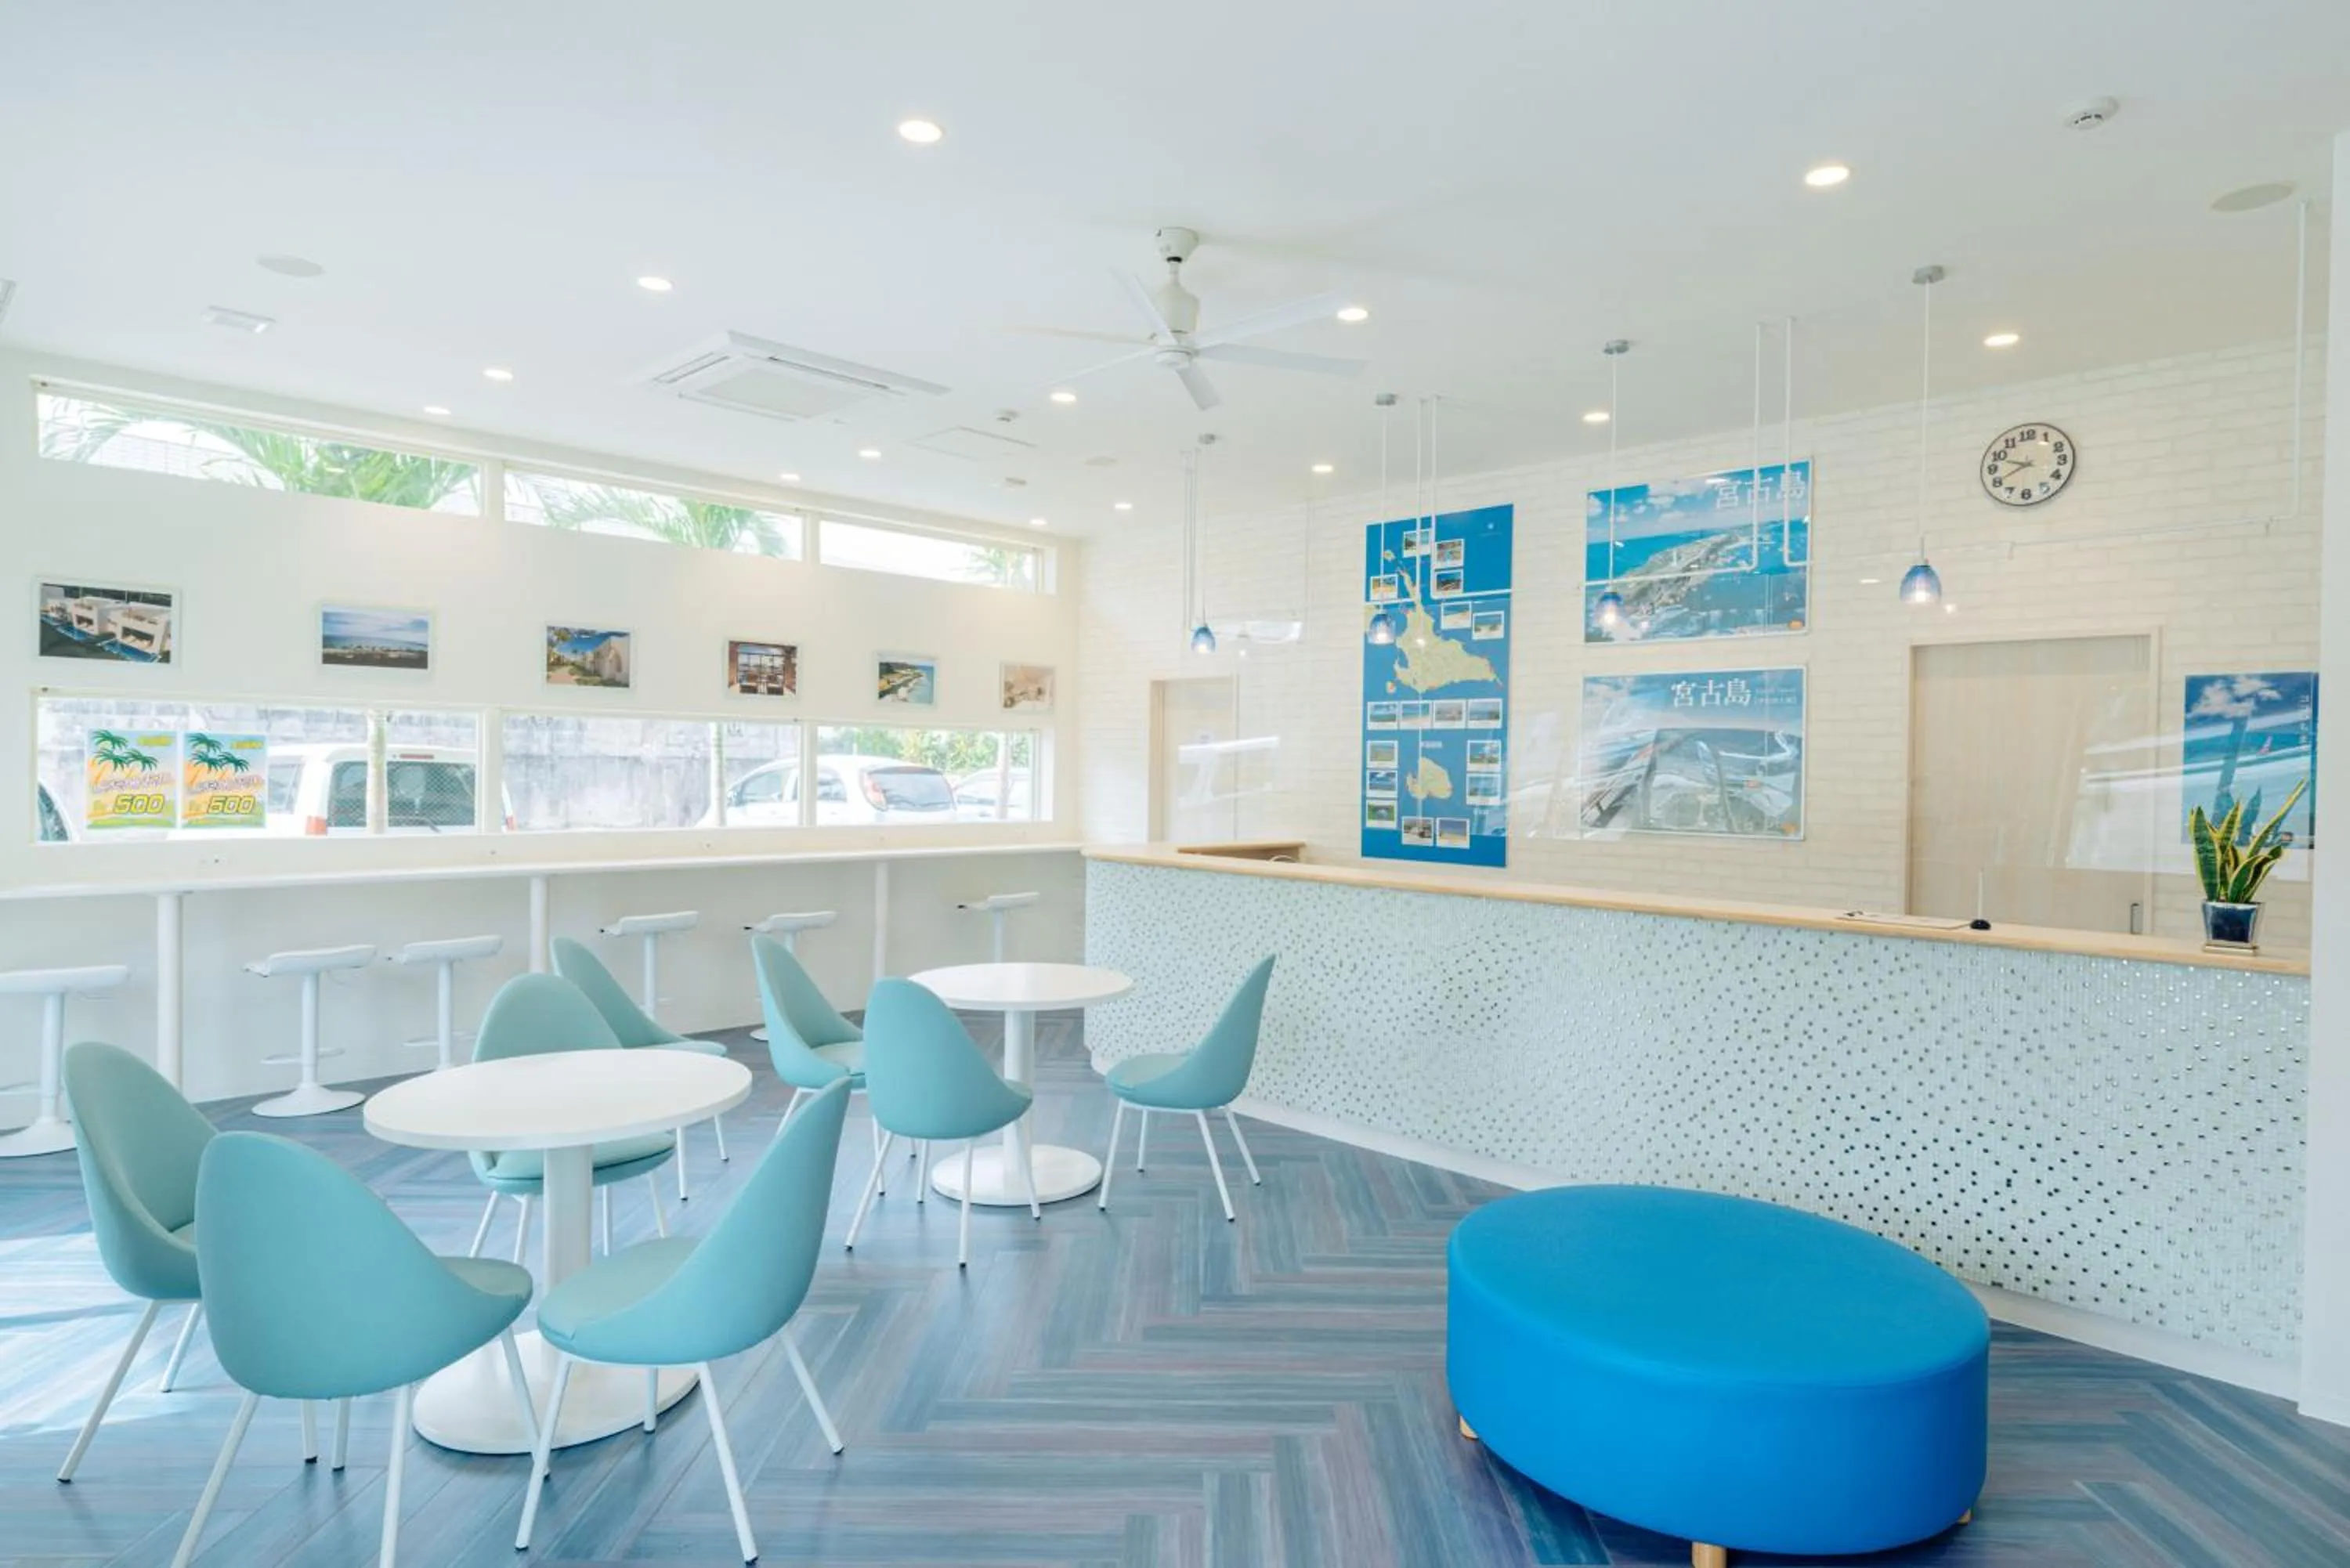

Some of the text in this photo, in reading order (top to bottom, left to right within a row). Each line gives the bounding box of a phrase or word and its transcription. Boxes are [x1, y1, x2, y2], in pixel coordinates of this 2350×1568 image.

[2019, 429, 2035, 442] 12
[2043, 432, 2049, 443] 1
[2005, 438, 2016, 449] 11
[2053, 441, 2063, 453] 2
[1992, 450, 2007, 461] 10
[2057, 453, 2067, 465] 3
[1987, 464, 1998, 475] 9
[2050, 469, 2062, 480] 4
[1992, 477, 2002, 487] 8
[2039, 482, 2050, 494] 5
[2005, 486, 2016, 498] 7
[2021, 488, 2031, 500] 6
[1670, 677, 1752, 707] 宮古島
